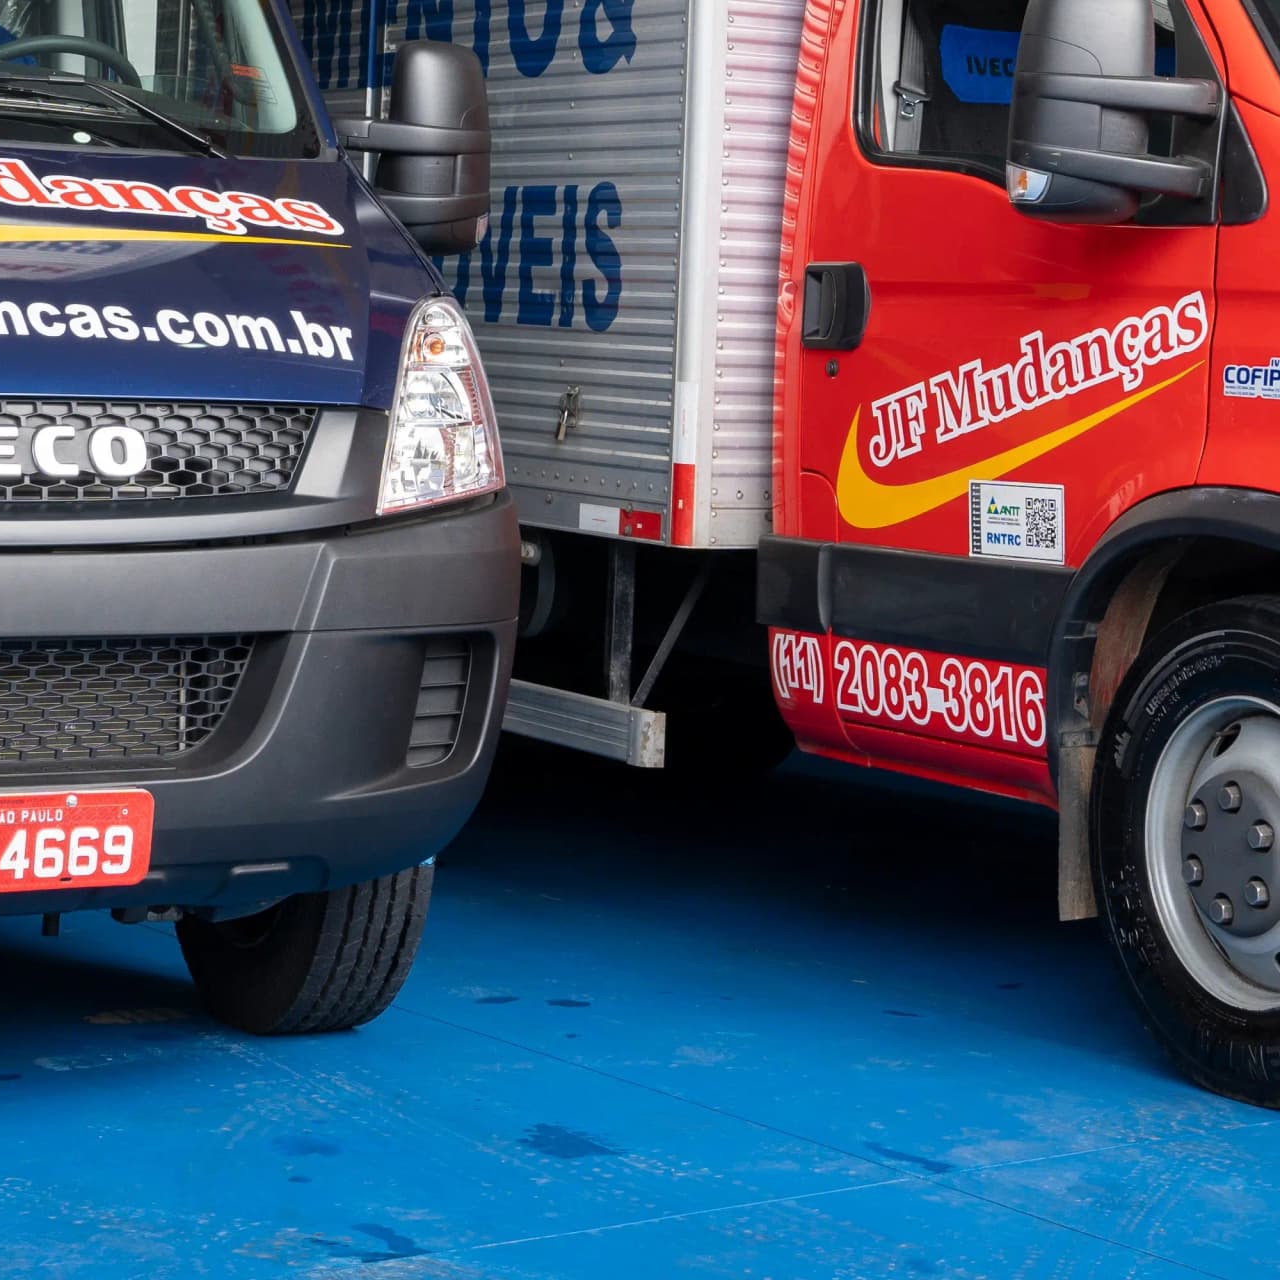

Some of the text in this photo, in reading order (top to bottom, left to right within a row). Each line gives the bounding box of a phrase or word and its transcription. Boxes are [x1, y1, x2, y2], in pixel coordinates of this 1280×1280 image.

[433, 181, 623, 333] VEIS
[869, 290, 1209, 468] JF Mudanças
[986, 532, 1022, 546] RNTRC
[999, 505, 1020, 517] ANTT
[772, 632, 824, 704] (11)
[834, 640, 1047, 747] 2083-3816
[21, 808, 64, 823] PAULO
